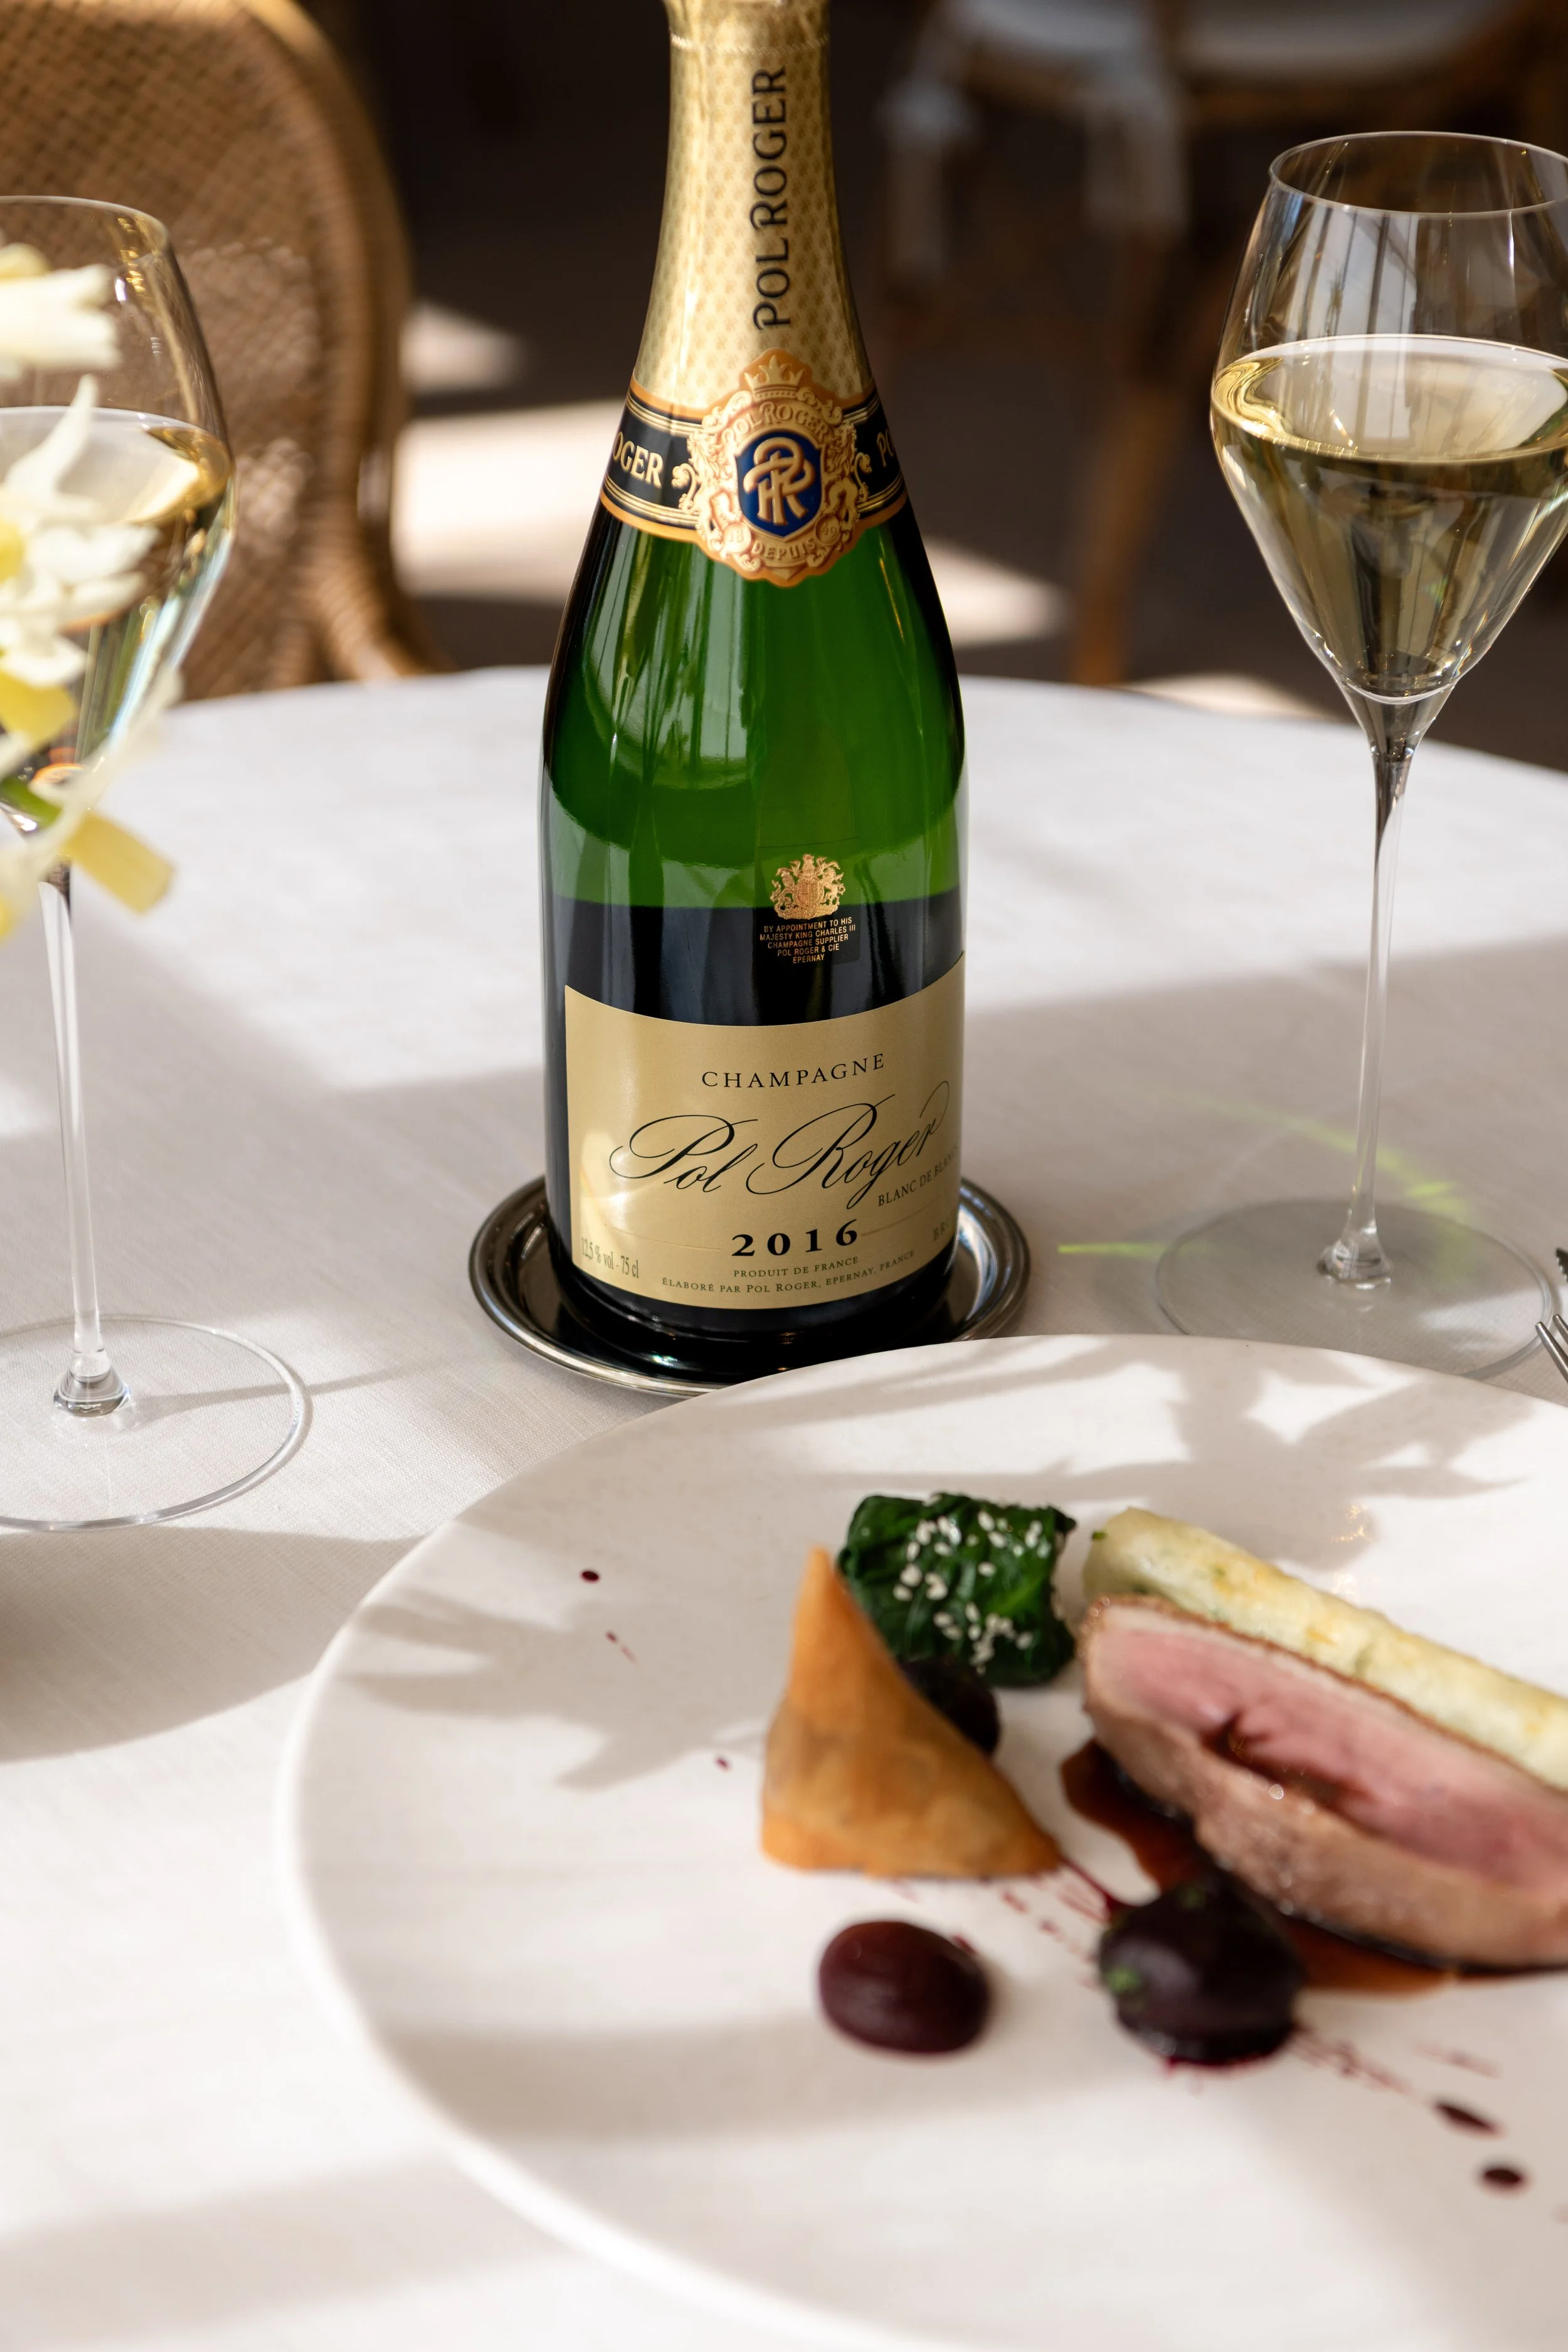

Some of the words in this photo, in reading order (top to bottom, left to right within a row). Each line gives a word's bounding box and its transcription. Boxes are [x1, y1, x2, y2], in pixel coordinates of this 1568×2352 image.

[750, 66, 788, 230] ROGER
[753, 238, 791, 331] POL
[759, 401, 829, 443] ROGER
[751, 538, 815, 560] DEPUIS
[760, 933, 793, 941] MAJESTY
[796, 931, 813, 939] KING
[815, 926, 847, 938] CHARLES
[768, 939, 813, 949] CHAMPAGNE
[815, 934, 849, 945] SUPPLIER
[776, 921, 827, 932] APPOINTMENT
[841, 916, 852, 925] HIS
[793, 954, 825, 964] EPERNAY
[794, 946, 818, 955] ROGER
[828, 943, 839, 951] CIE
[701, 1053, 884, 1088] CHAMPAGNE
[609, 1115, 758, 1192] Pol
[746, 1081, 950, 1210] Roger
[877, 1180, 916, 1207] BLANC
[919, 1170, 931, 1187] DE
[731, 1219, 858, 1257] 2016
[581, 1237, 593, 1261] 12,5
[595, 1245, 601, 1263] %
[603, 1251, 614, 1269] vol
[621, 1255, 630, 1275] 75
[632, 1259, 639, 1278] cl
[662, 1277, 714, 1291] ÉLABORÉ
[826, 1267, 877, 1286] EPERNAY,
[880, 1249, 914, 1271] FRANCE
[733, 1268, 788, 1278] PRODUIT
[793, 1266, 809, 1274] DE
[815, 1256, 859, 1272] FRANCE
